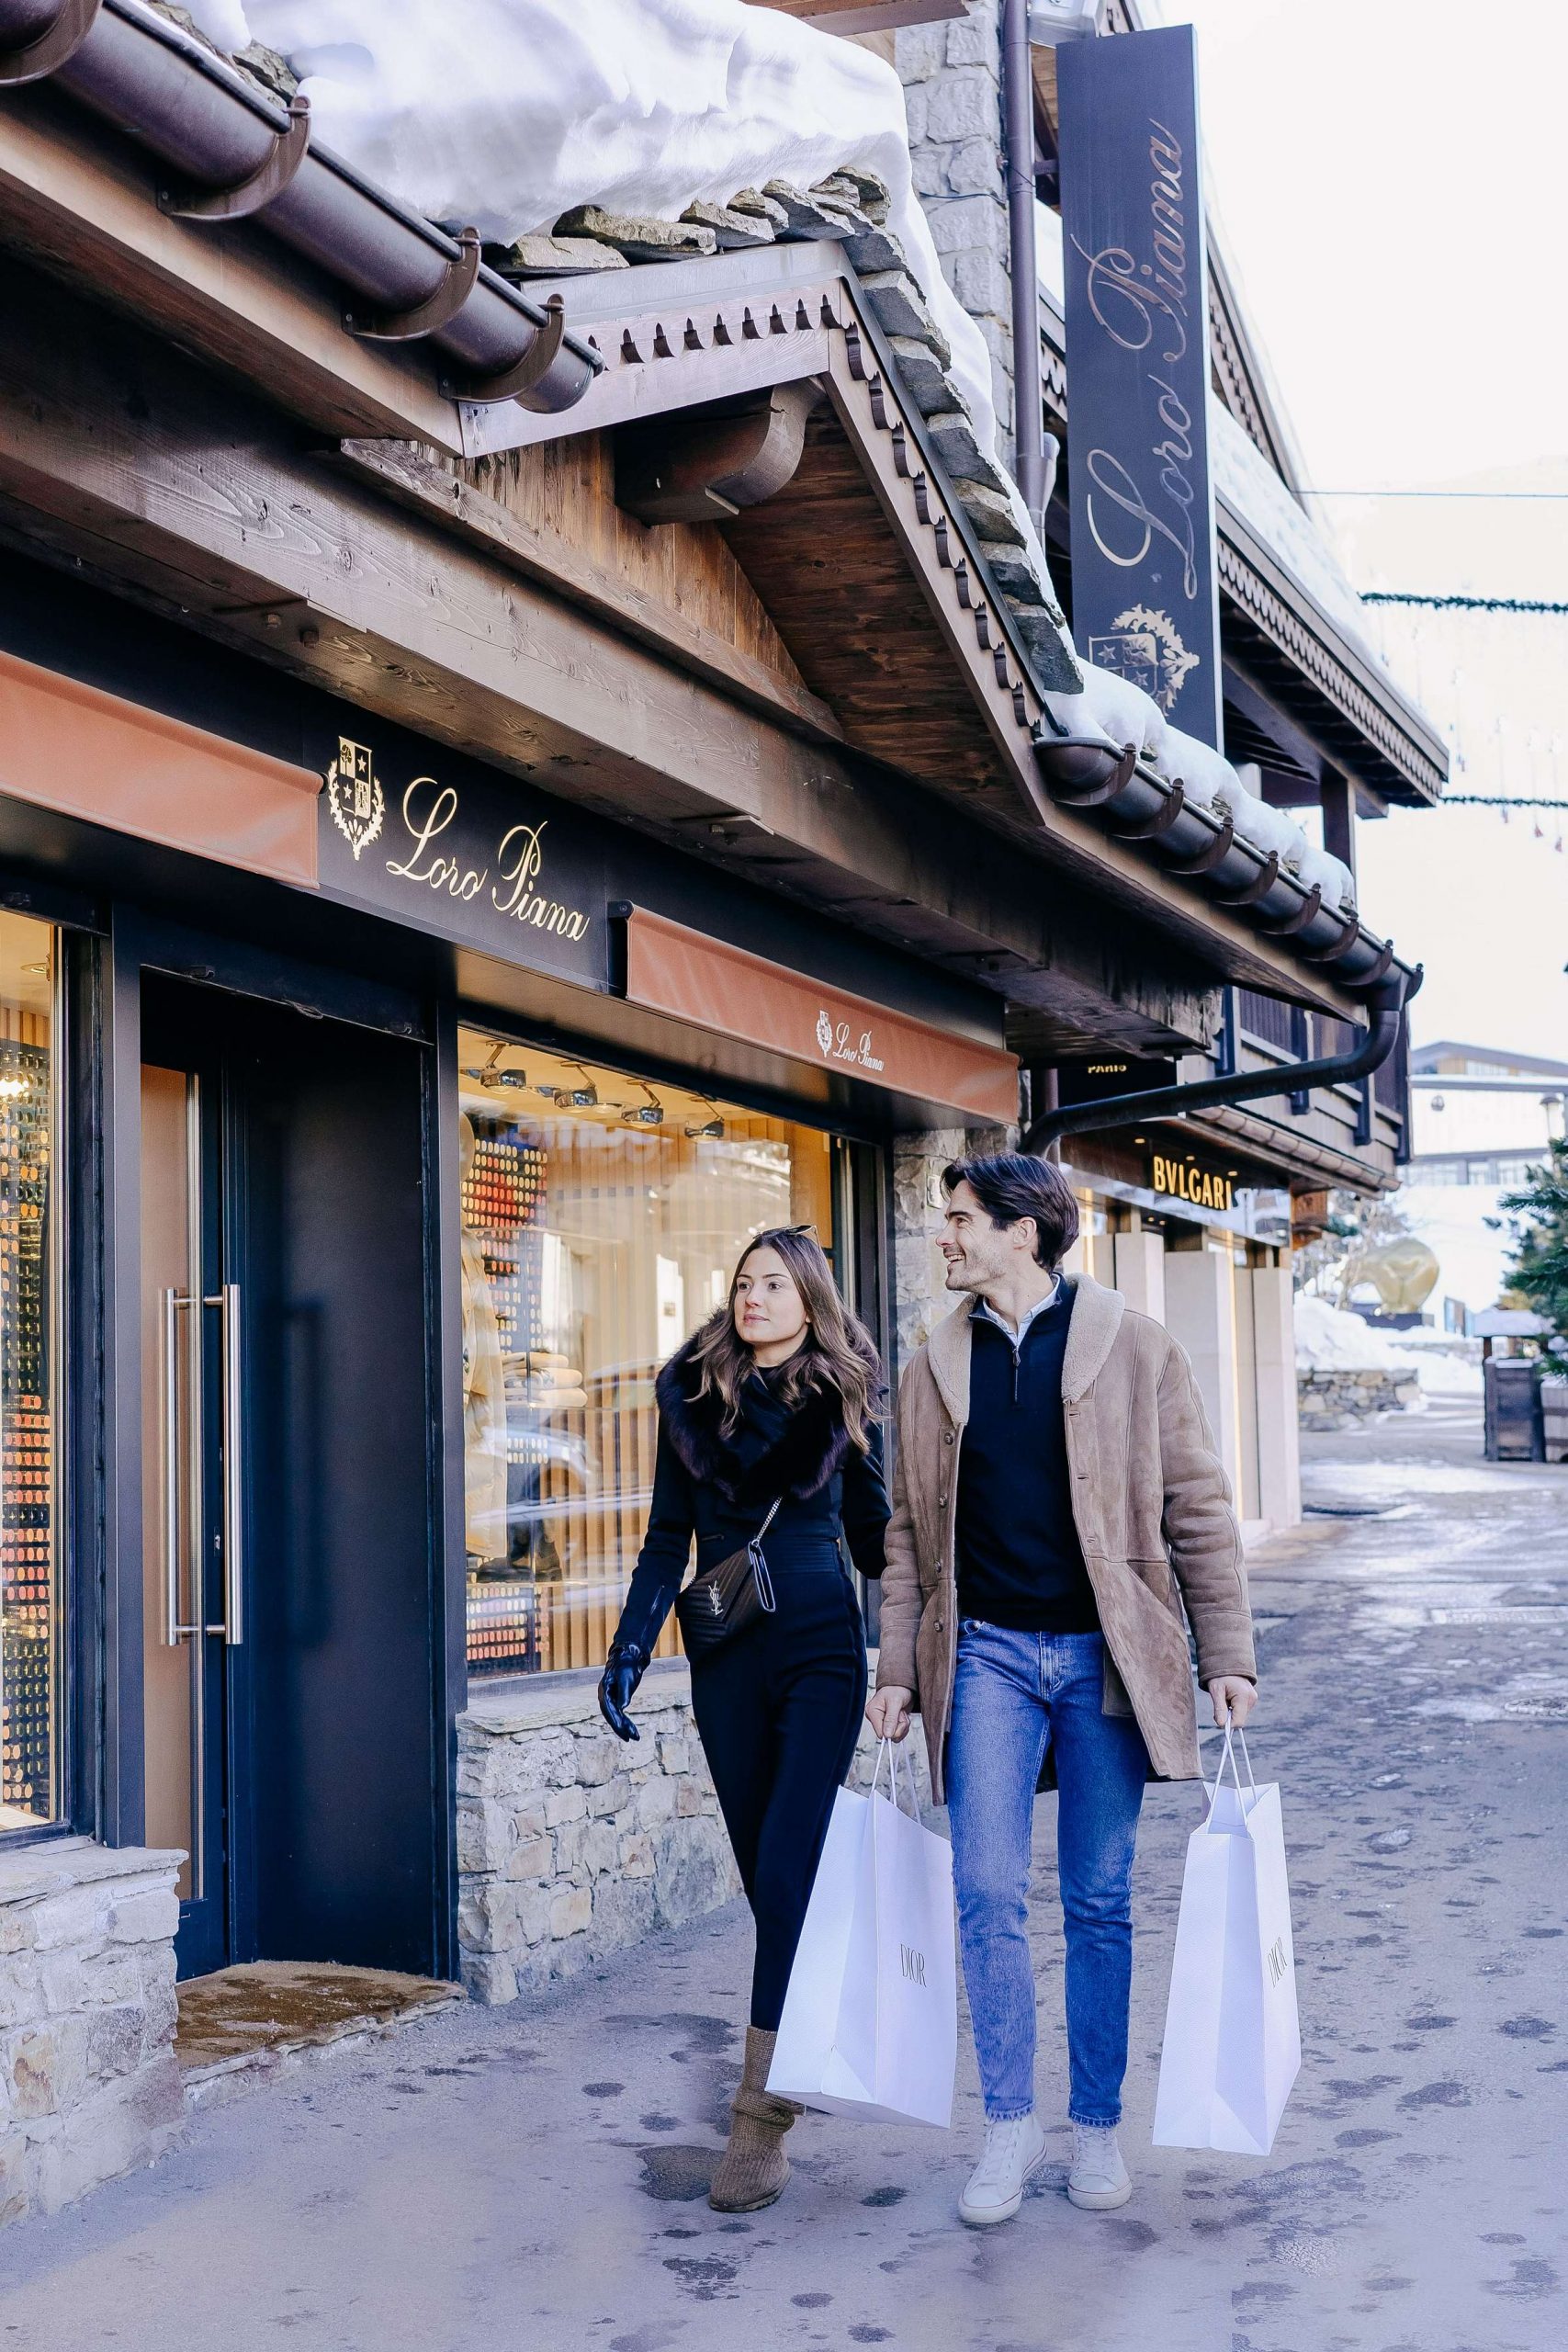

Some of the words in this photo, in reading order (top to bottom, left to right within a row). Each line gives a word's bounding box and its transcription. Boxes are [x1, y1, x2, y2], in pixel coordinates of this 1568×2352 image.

[1069, 118, 1189, 363] Piana
[1087, 373, 1198, 600] Loro
[385, 777, 489, 901] Loro
[491, 820, 591, 942] Piana
[832, 1022, 858, 1062] Loro
[857, 1030, 886, 1072] Piana
[1153, 1156, 1233, 1211] BVLGARI
[900, 1943, 927, 1988] DIOR
